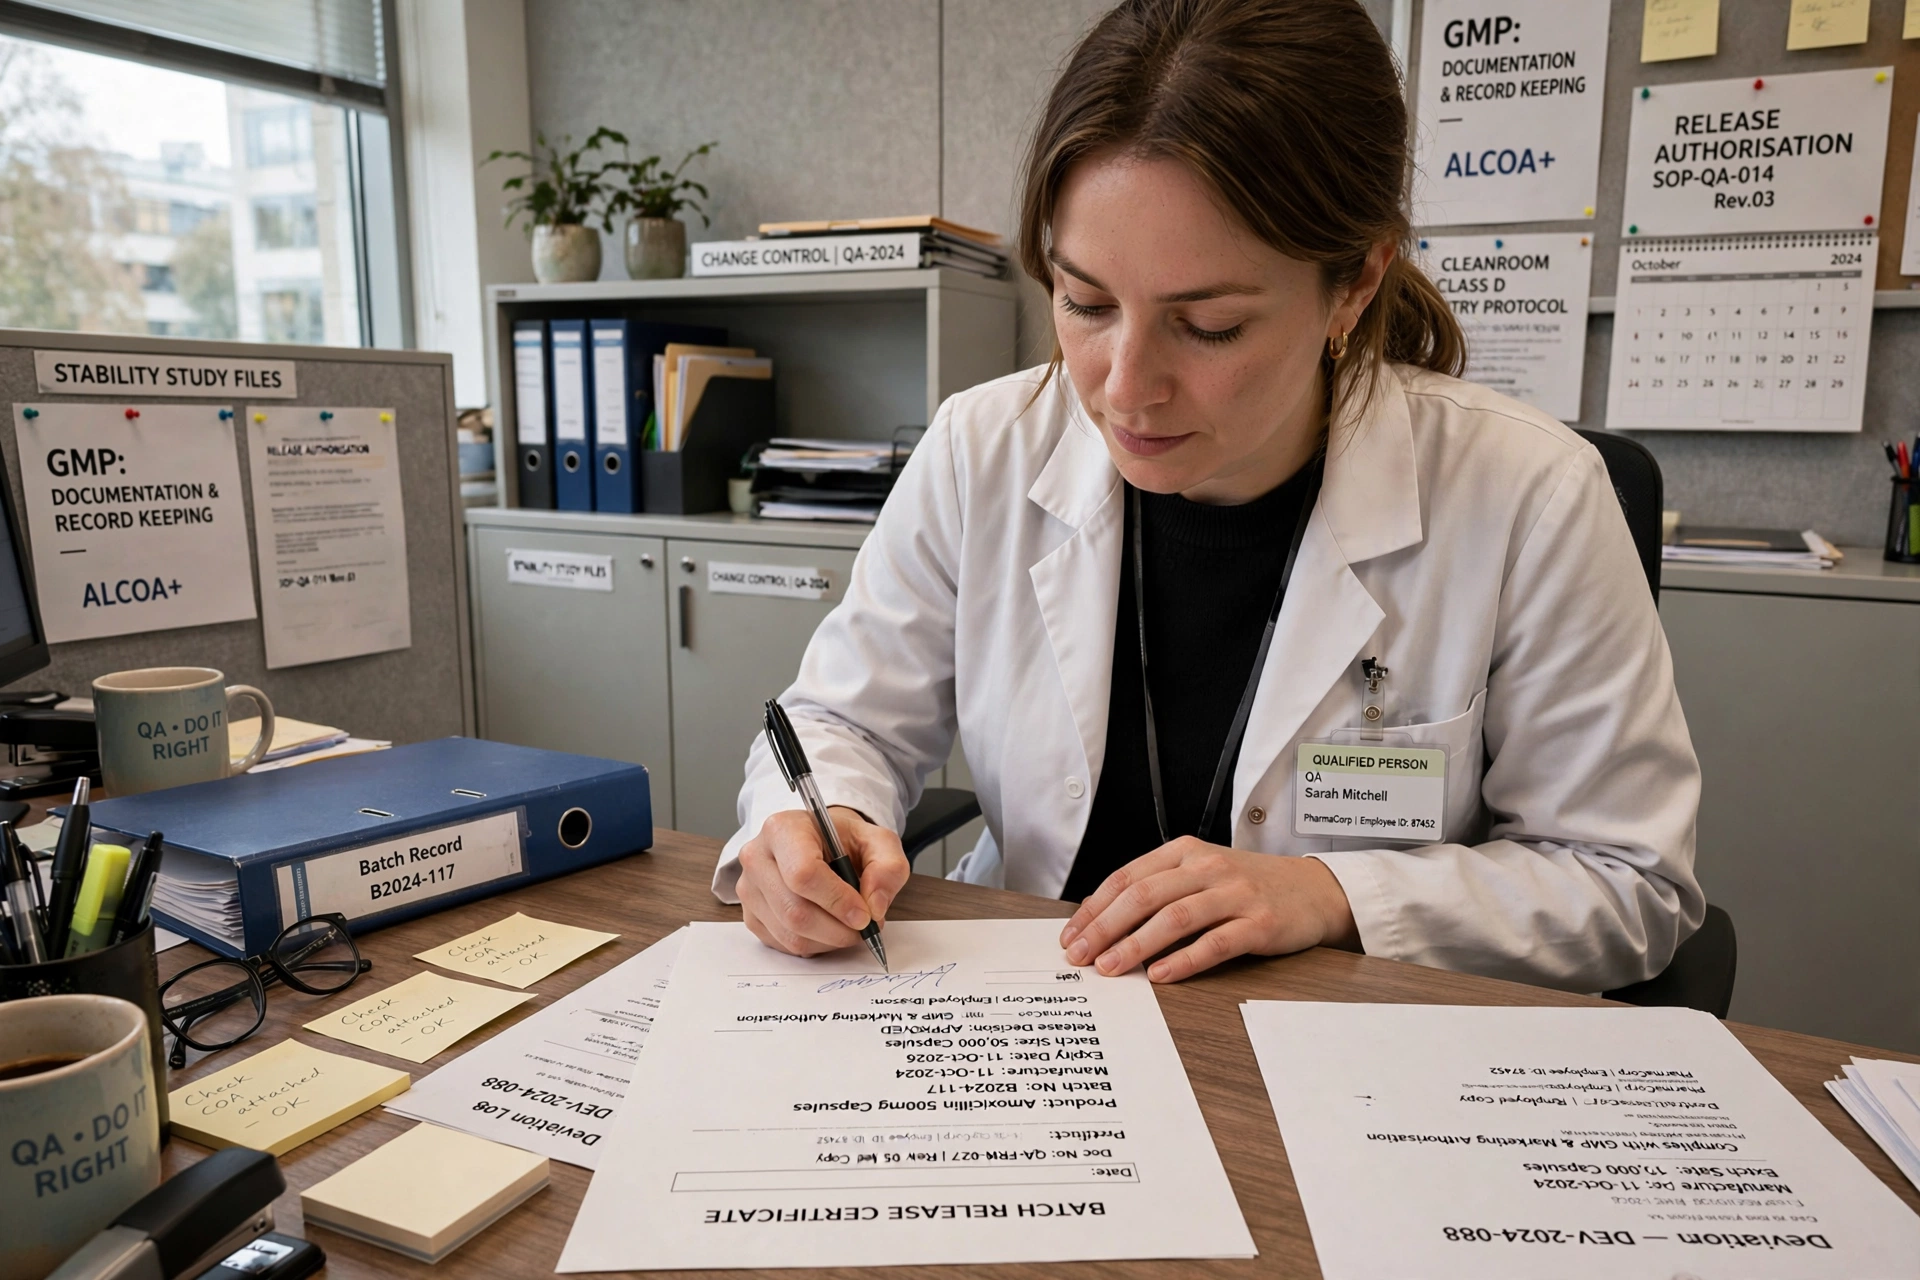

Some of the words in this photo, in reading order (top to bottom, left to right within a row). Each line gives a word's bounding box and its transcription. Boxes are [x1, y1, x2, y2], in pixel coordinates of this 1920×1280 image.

[1444, 16, 1521, 48] GMP:
[1442, 51, 1576, 77] DOCUMENTATION
[1440, 85, 1451, 102] &
[1455, 82, 1516, 102] RECORD
[1520, 77, 1586, 99] KEEPING
[1675, 109, 1781, 136] RELEASE
[1654, 133, 1853, 164] AUTHORISATION
[1445, 148, 1556, 178] ALCOA+
[1653, 165, 1775, 188] SOP-QA-014
[1714, 191, 1775, 210] Rev.03
[701, 249, 758, 267] CHANGE
[762, 247, 829, 265] CONTROL
[844, 245, 905, 261] QA-2024
[1441, 255, 1549, 272] CLEANROOM
[1632, 258, 1680, 271] October
[1831, 253, 1862, 265] 2024
[1437, 278, 1488, 293] CLASS
[1494, 278, 1506, 292] D
[1448, 300, 1479, 314] TRY
[1484, 299, 1568, 314] PROTOCOL
[54, 363, 160, 386] STABILITY
[166, 367, 228, 388] STUDY
[234, 370, 282, 388] FILES
[47, 448, 126, 477] GMP:
[51, 483, 203, 506] DOCUMENTATION
[208, 483, 220, 498] &
[55, 510, 134, 532] RECORD
[139, 506, 213, 527] KEEPING
[82, 577, 183, 608] ALCOA+
[137, 721, 166, 740] QA
[184, 715, 209, 735] DO
[212, 710, 221, 728] IT
[152, 736, 210, 760] RIGHT
[1313, 754, 1375, 768] QUALIFIED
[1378, 758, 1429, 770] PERSON
[1305, 787, 1339, 799] Sarah
[1342, 788, 1388, 801] Mitchell
[1304, 813, 1352, 826] PharmaCorp
[1360, 816, 1396, 827] Employee
[359, 851, 405, 876] Batch
[410, 835, 463, 864] Record
[370, 863, 455, 900] B2024-117
[448, 935, 500, 957] Check
[488, 934, 549, 966] attached
[464, 946, 497, 963] COA
[519, 952, 549, 966] OK
[341, 997, 400, 1025] Check
[388, 996, 460, 1034] attached
[832, 1012, 902, 1022] Marketing
[359, 1013, 397, 1033] COA
[420, 1017, 456, 1036] OK
[969, 1023, 1034, 1033] Decision:
[1038, 1023, 1097, 1032] Release
[885, 1039, 953, 1049] Capsules
[959, 1038, 1009, 1048] 50,000
[1055, 1037, 1100, 1046] Batch
[906, 1053, 1003, 1063] 11-Oct-2026
[1010, 1052, 1050, 1061] Date:
[895, 1067, 994, 1079] 11-Oct-2024
[1002, 1066, 1109, 1077] Manufacture:
[1618, 1068, 1694, 1078] PharmaCorp
[184, 1073, 254, 1106] Check
[238, 1067, 325, 1115] attached
[927, 1082, 1018, 1094] B2024-117
[1026, 1082, 1056, 1092] No:
[1063, 1081, 1112, 1092] Batch
[1625, 1084, 1706, 1094] PharmaCorp
[201, 1093, 245, 1116] COA
[272, 1096, 310, 1117] OK
[481, 1077, 613, 1120] DEV-2024-088
[793, 1100, 873, 1113] Capsules
[878, 1100, 937, 1111] 500mg
[1043, 1098, 1118, 1108] Product:
[1459, 1094, 1495, 1103] Copy
[11, 1133, 65, 1166] QA
[92, 1103, 129, 1142] DO
[134, 1084, 147, 1117] IT
[511, 1112, 602, 1146] Deviation
[1477, 1135, 1557, 1148] Marketing
[1581, 1140, 1618, 1150] GMP
[1623, 1140, 1659, 1151] with
[1665, 1141, 1739, 1152] Complies
[816, 1153, 851, 1164] Copy
[1052, 1150, 1078, 1159] No:
[1083, 1149, 1112, 1158] Doc
[34, 1135, 129, 1198] RIGHT
[1092, 1168, 1132, 1178] Date:
[1523, 1162, 1602, 1175] Capsules
[1534, 1179, 1640, 1192] 11-Oct-2024
[1682, 1181, 1794, 1194] Manufacture
[704, 1206, 879, 1223] CERTIFICATE
[888, 1204, 1008, 1220] RELEASE
[1018, 1202, 1106, 1218] BATCH
[1443, 1226, 1636, 1246] DEV-2024-088
